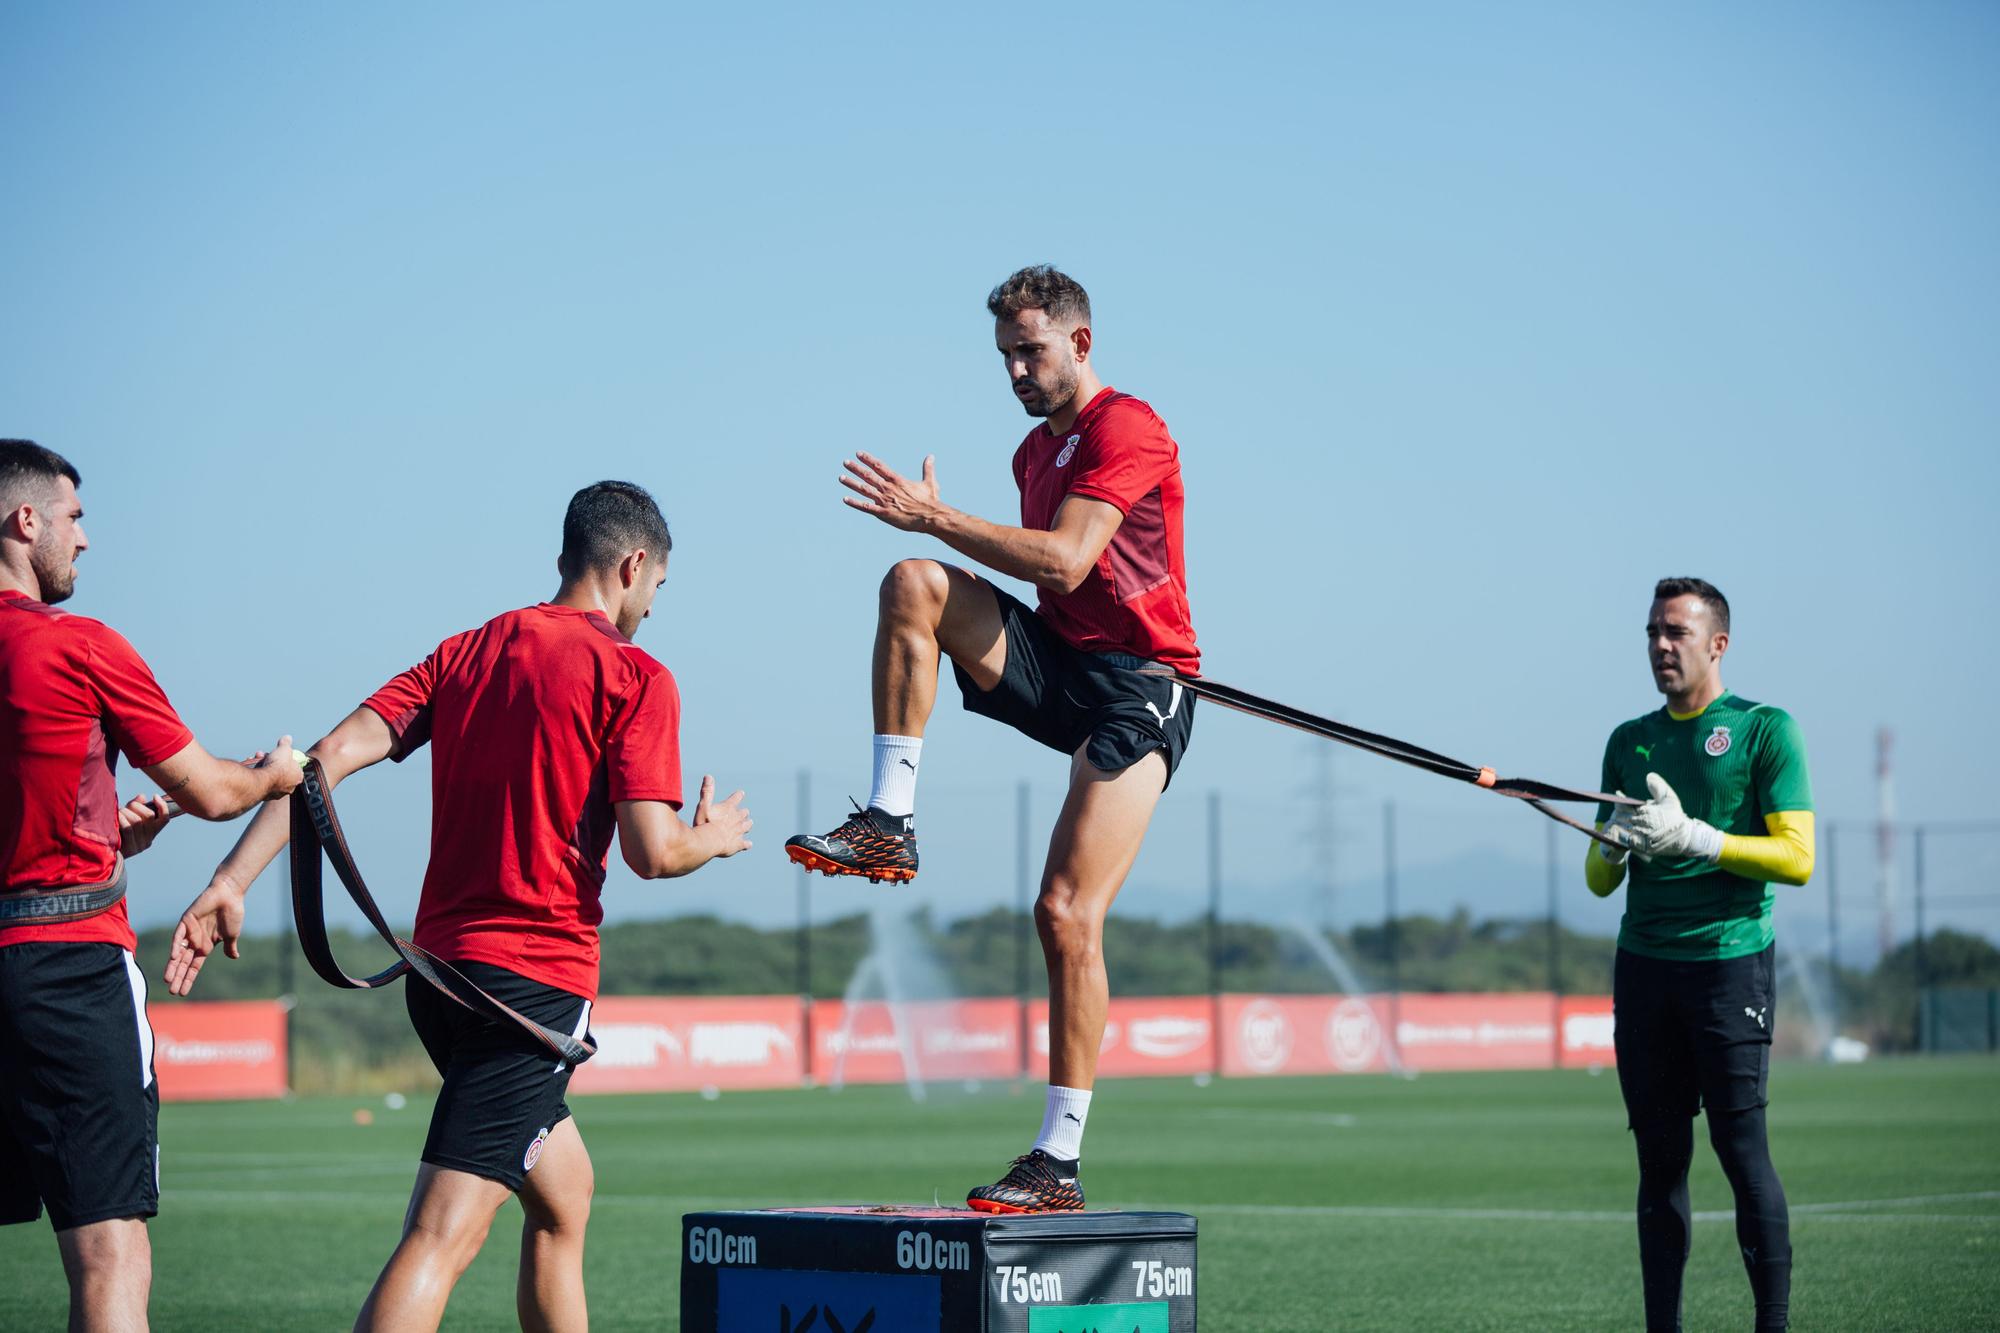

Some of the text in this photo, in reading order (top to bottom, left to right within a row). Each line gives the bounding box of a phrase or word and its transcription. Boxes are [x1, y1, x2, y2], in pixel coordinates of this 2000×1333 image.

[689, 1227, 757, 1264] 60cm
[896, 1231, 970, 1271] 60cm
[996, 1266, 1063, 1303] 75cm
[1132, 1261, 1192, 1298] 75cm
